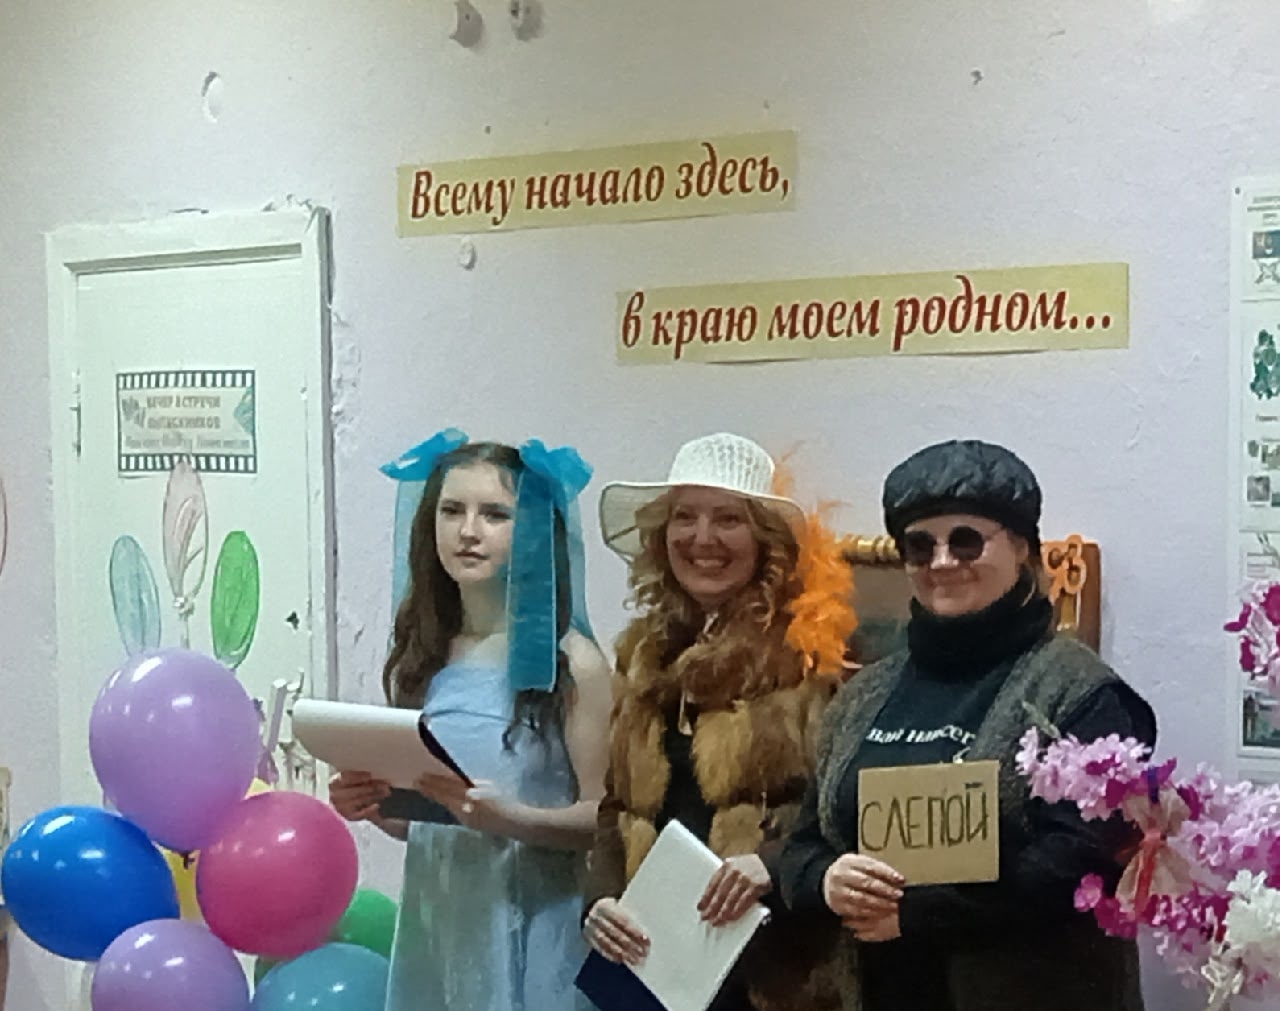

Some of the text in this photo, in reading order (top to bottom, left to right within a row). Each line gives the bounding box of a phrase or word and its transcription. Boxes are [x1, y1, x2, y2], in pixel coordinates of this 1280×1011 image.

[410, 141, 790, 226] Всему начало здесь,
[621, 274, 1113, 360] в краю моем родном...
[860, 782, 989, 852] СЛЕПОЙ
